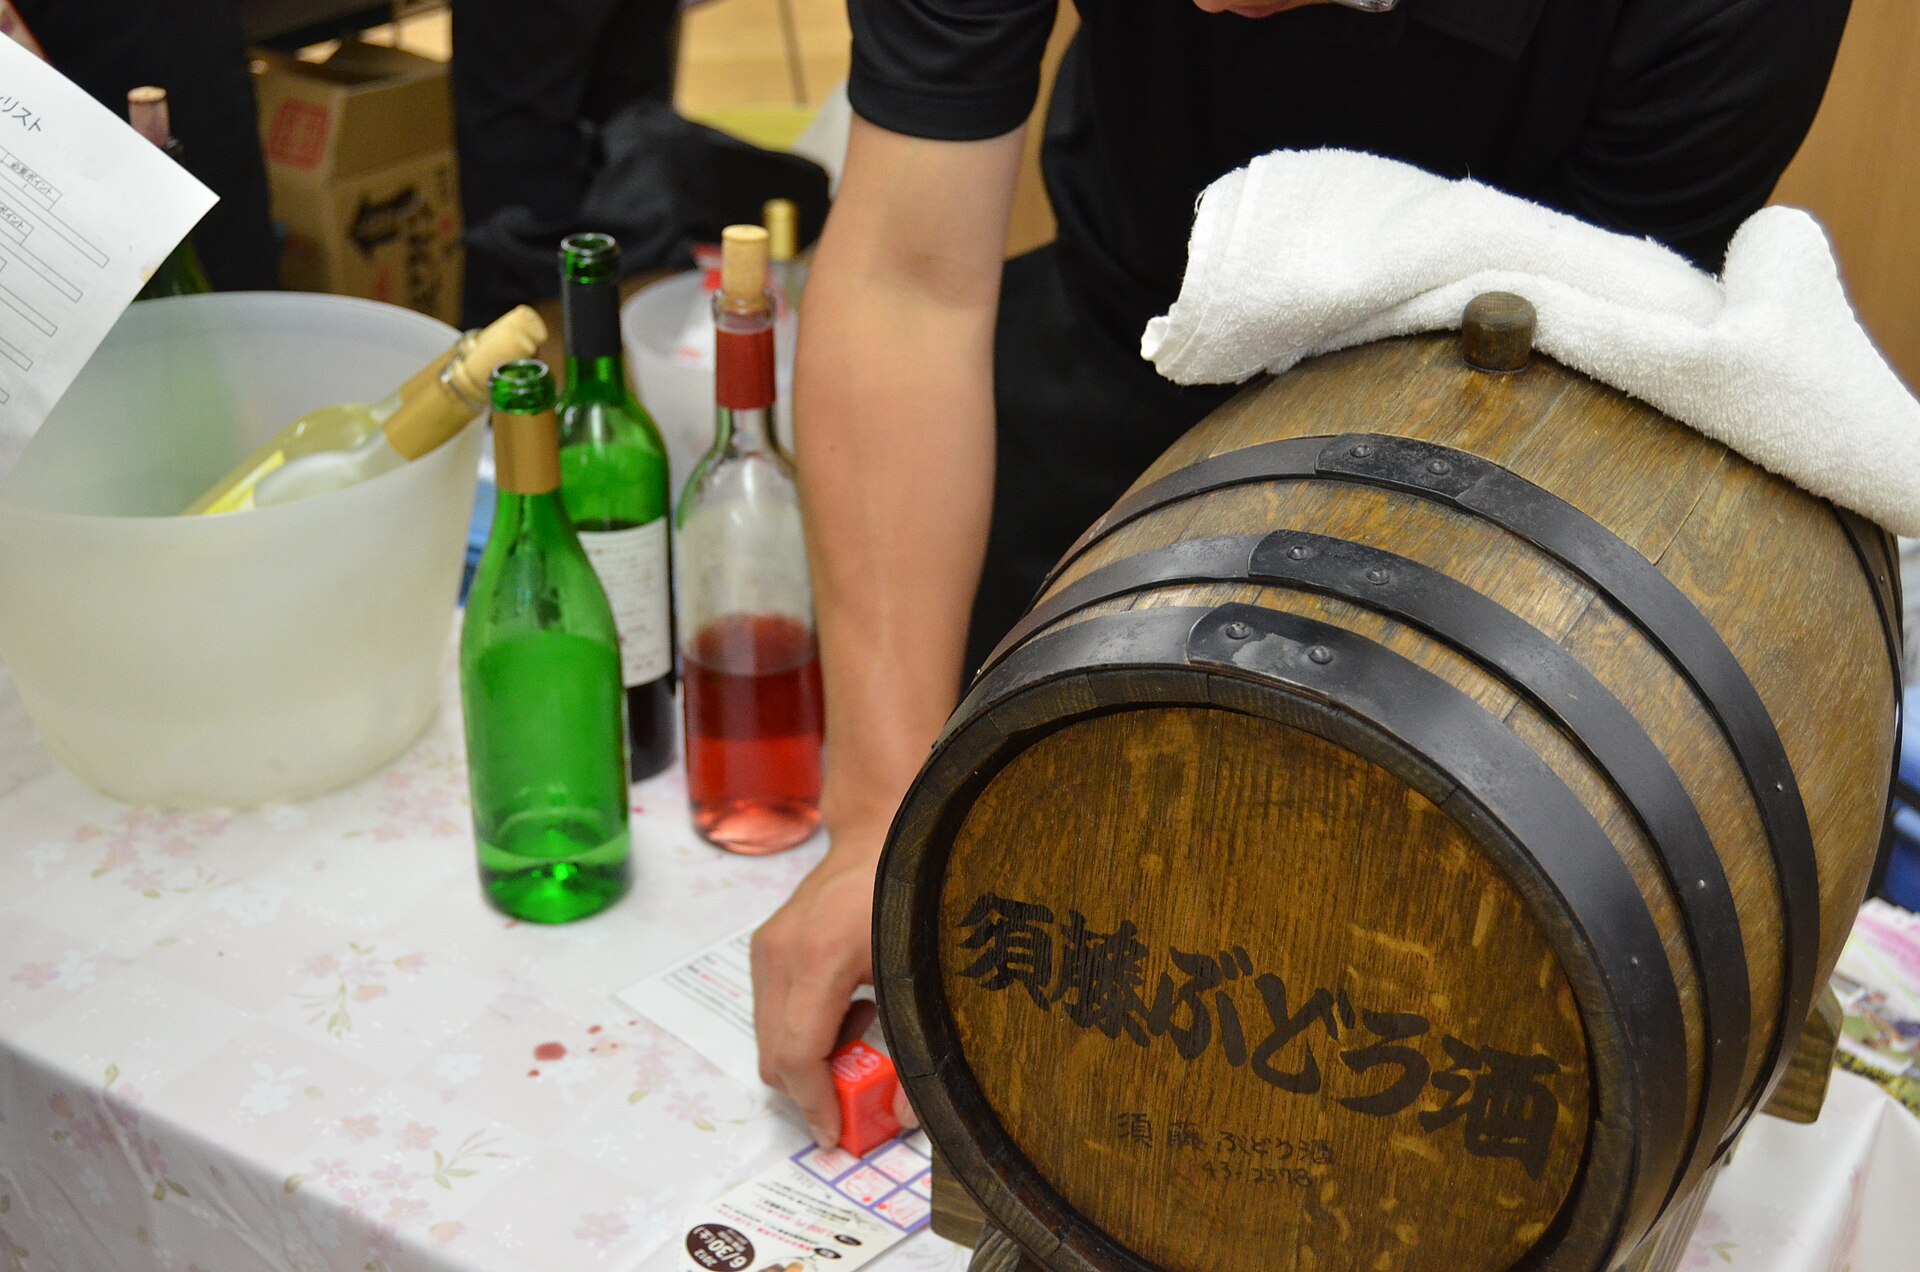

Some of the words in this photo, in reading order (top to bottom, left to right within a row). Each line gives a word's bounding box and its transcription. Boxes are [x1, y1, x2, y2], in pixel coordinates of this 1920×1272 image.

[957, 892, 1561, 1182] 須藤ぶどう酒
